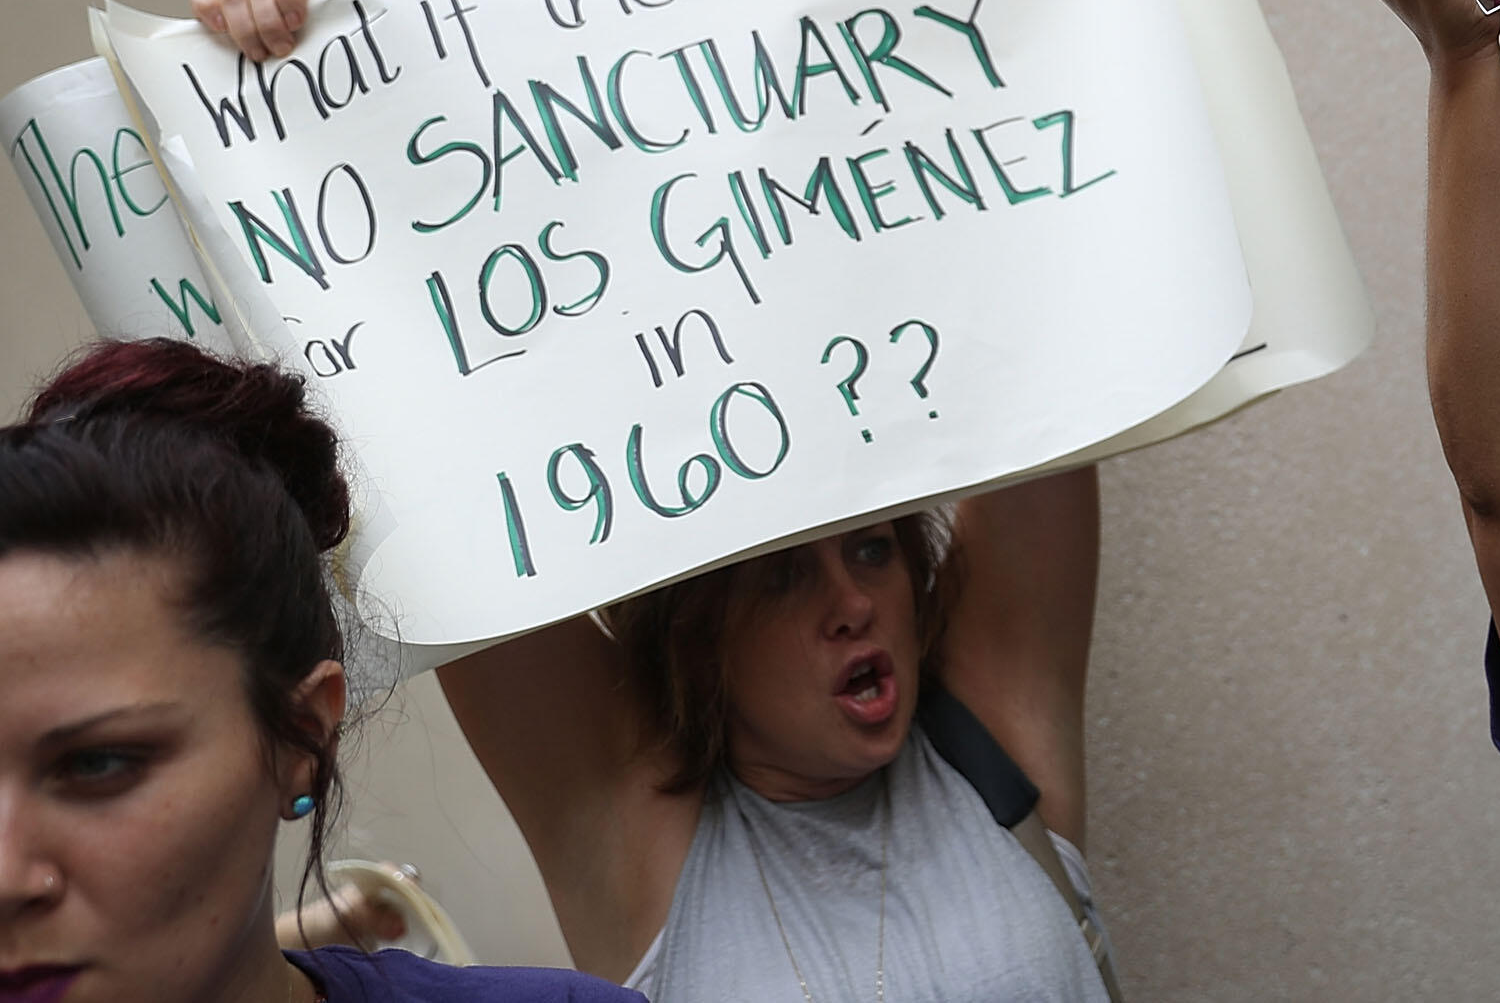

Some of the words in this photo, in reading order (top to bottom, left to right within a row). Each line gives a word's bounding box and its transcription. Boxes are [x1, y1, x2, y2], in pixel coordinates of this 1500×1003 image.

[182, 0, 400, 148] What
[227, 162, 378, 290] NO
[426, 220, 611, 375] LOS
[650, 108, 1118, 304] GIMÉNEZ
[620, 307, 734, 388] in
[497, 380, 791, 578] 1960
[820, 318, 941, 444] ??
